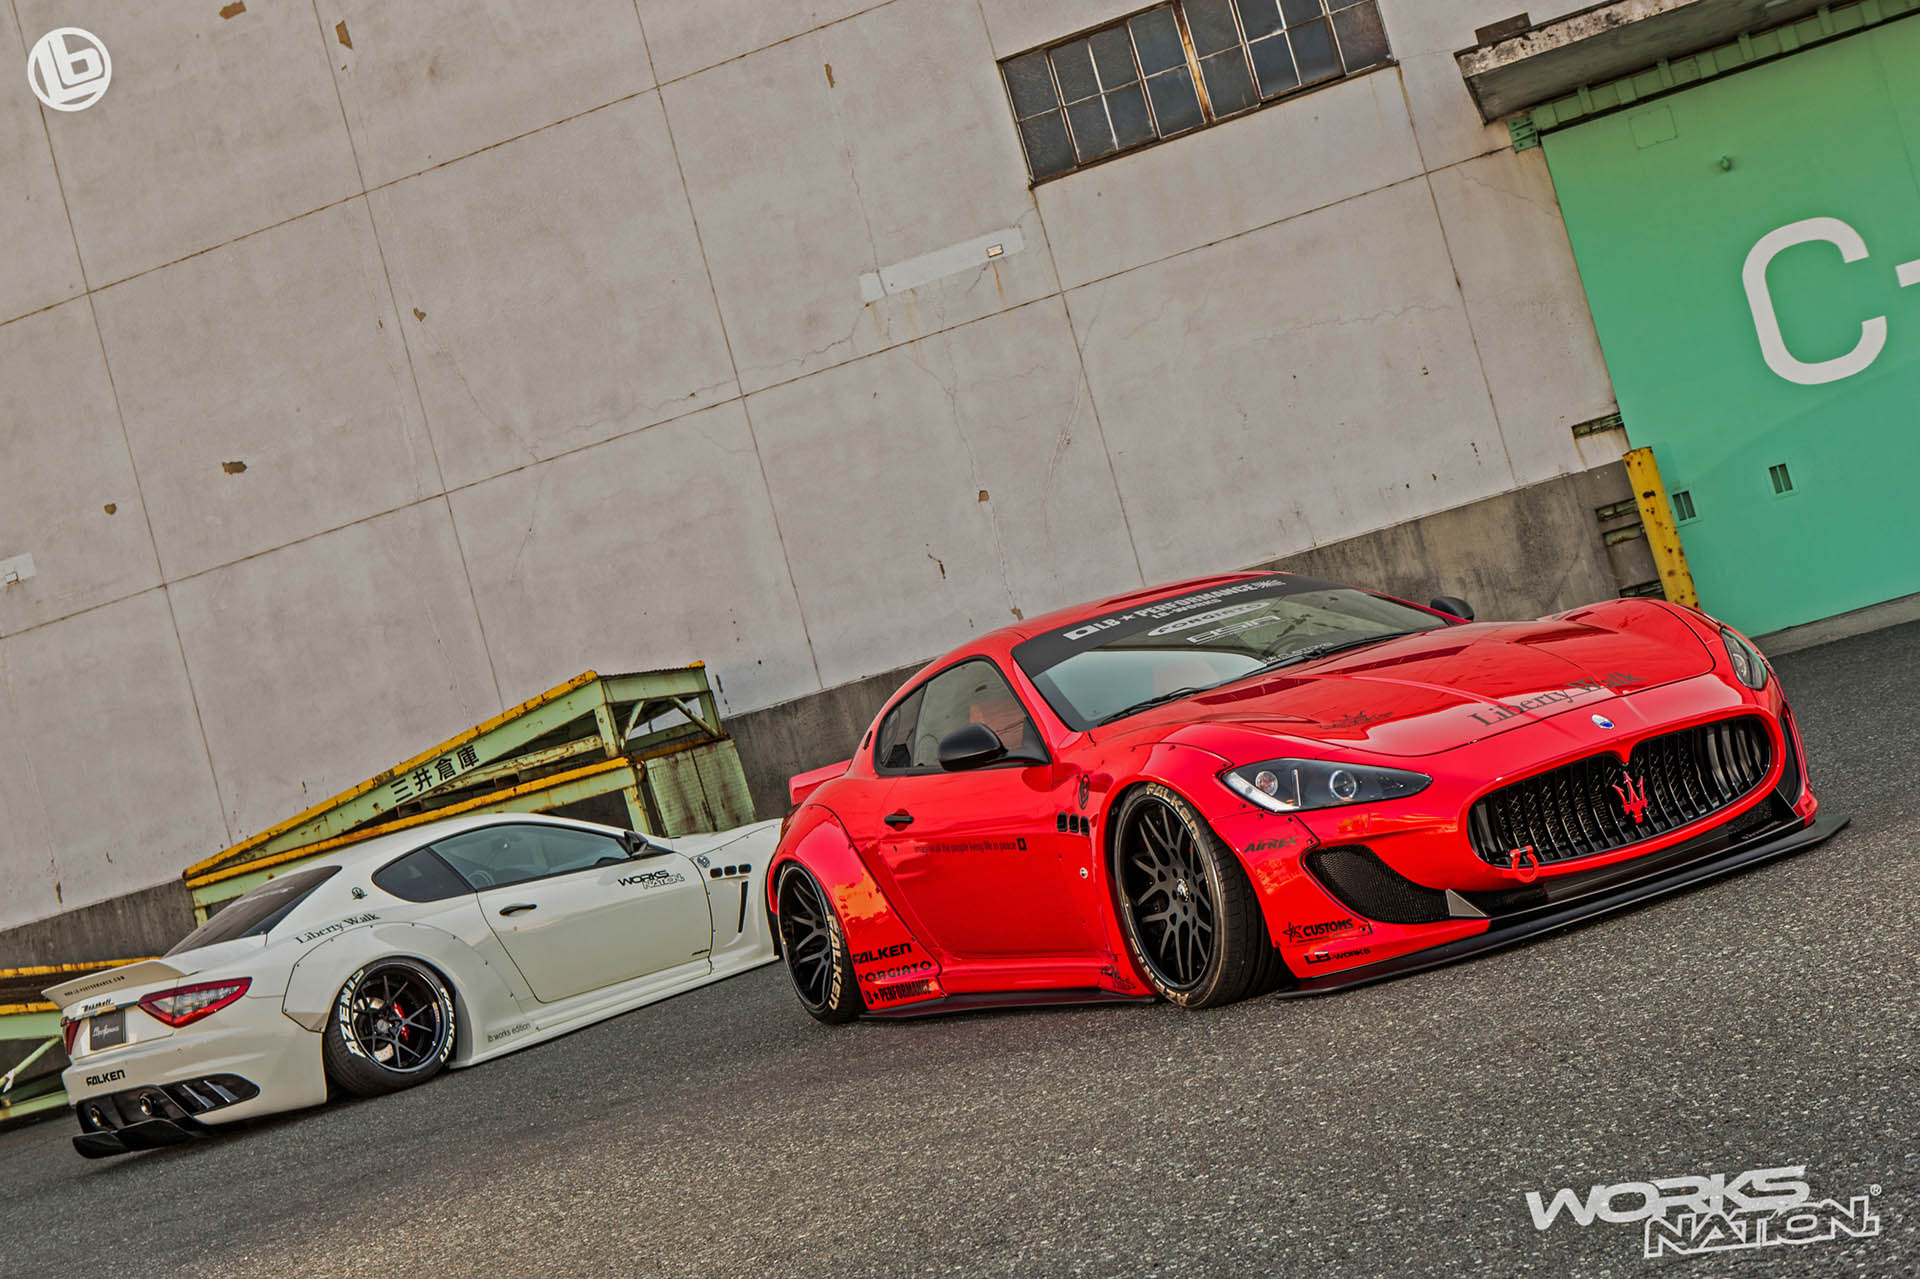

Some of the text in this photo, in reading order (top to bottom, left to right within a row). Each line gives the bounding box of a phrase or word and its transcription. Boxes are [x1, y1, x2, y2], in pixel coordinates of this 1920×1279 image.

[1469, 671, 1647, 726] Liberty Walk
[390, 744, 480, 803] 三井倉庫
[617, 870, 670, 886] WORKS
[295, 912, 381, 944] Liberty Walk
[1303, 919, 1354, 937] CUSTOMS
[827, 914, 842, 1010] FALKEN
[852, 943, 912, 964] FALKEN
[86, 1069, 126, 1087] FALKEN
